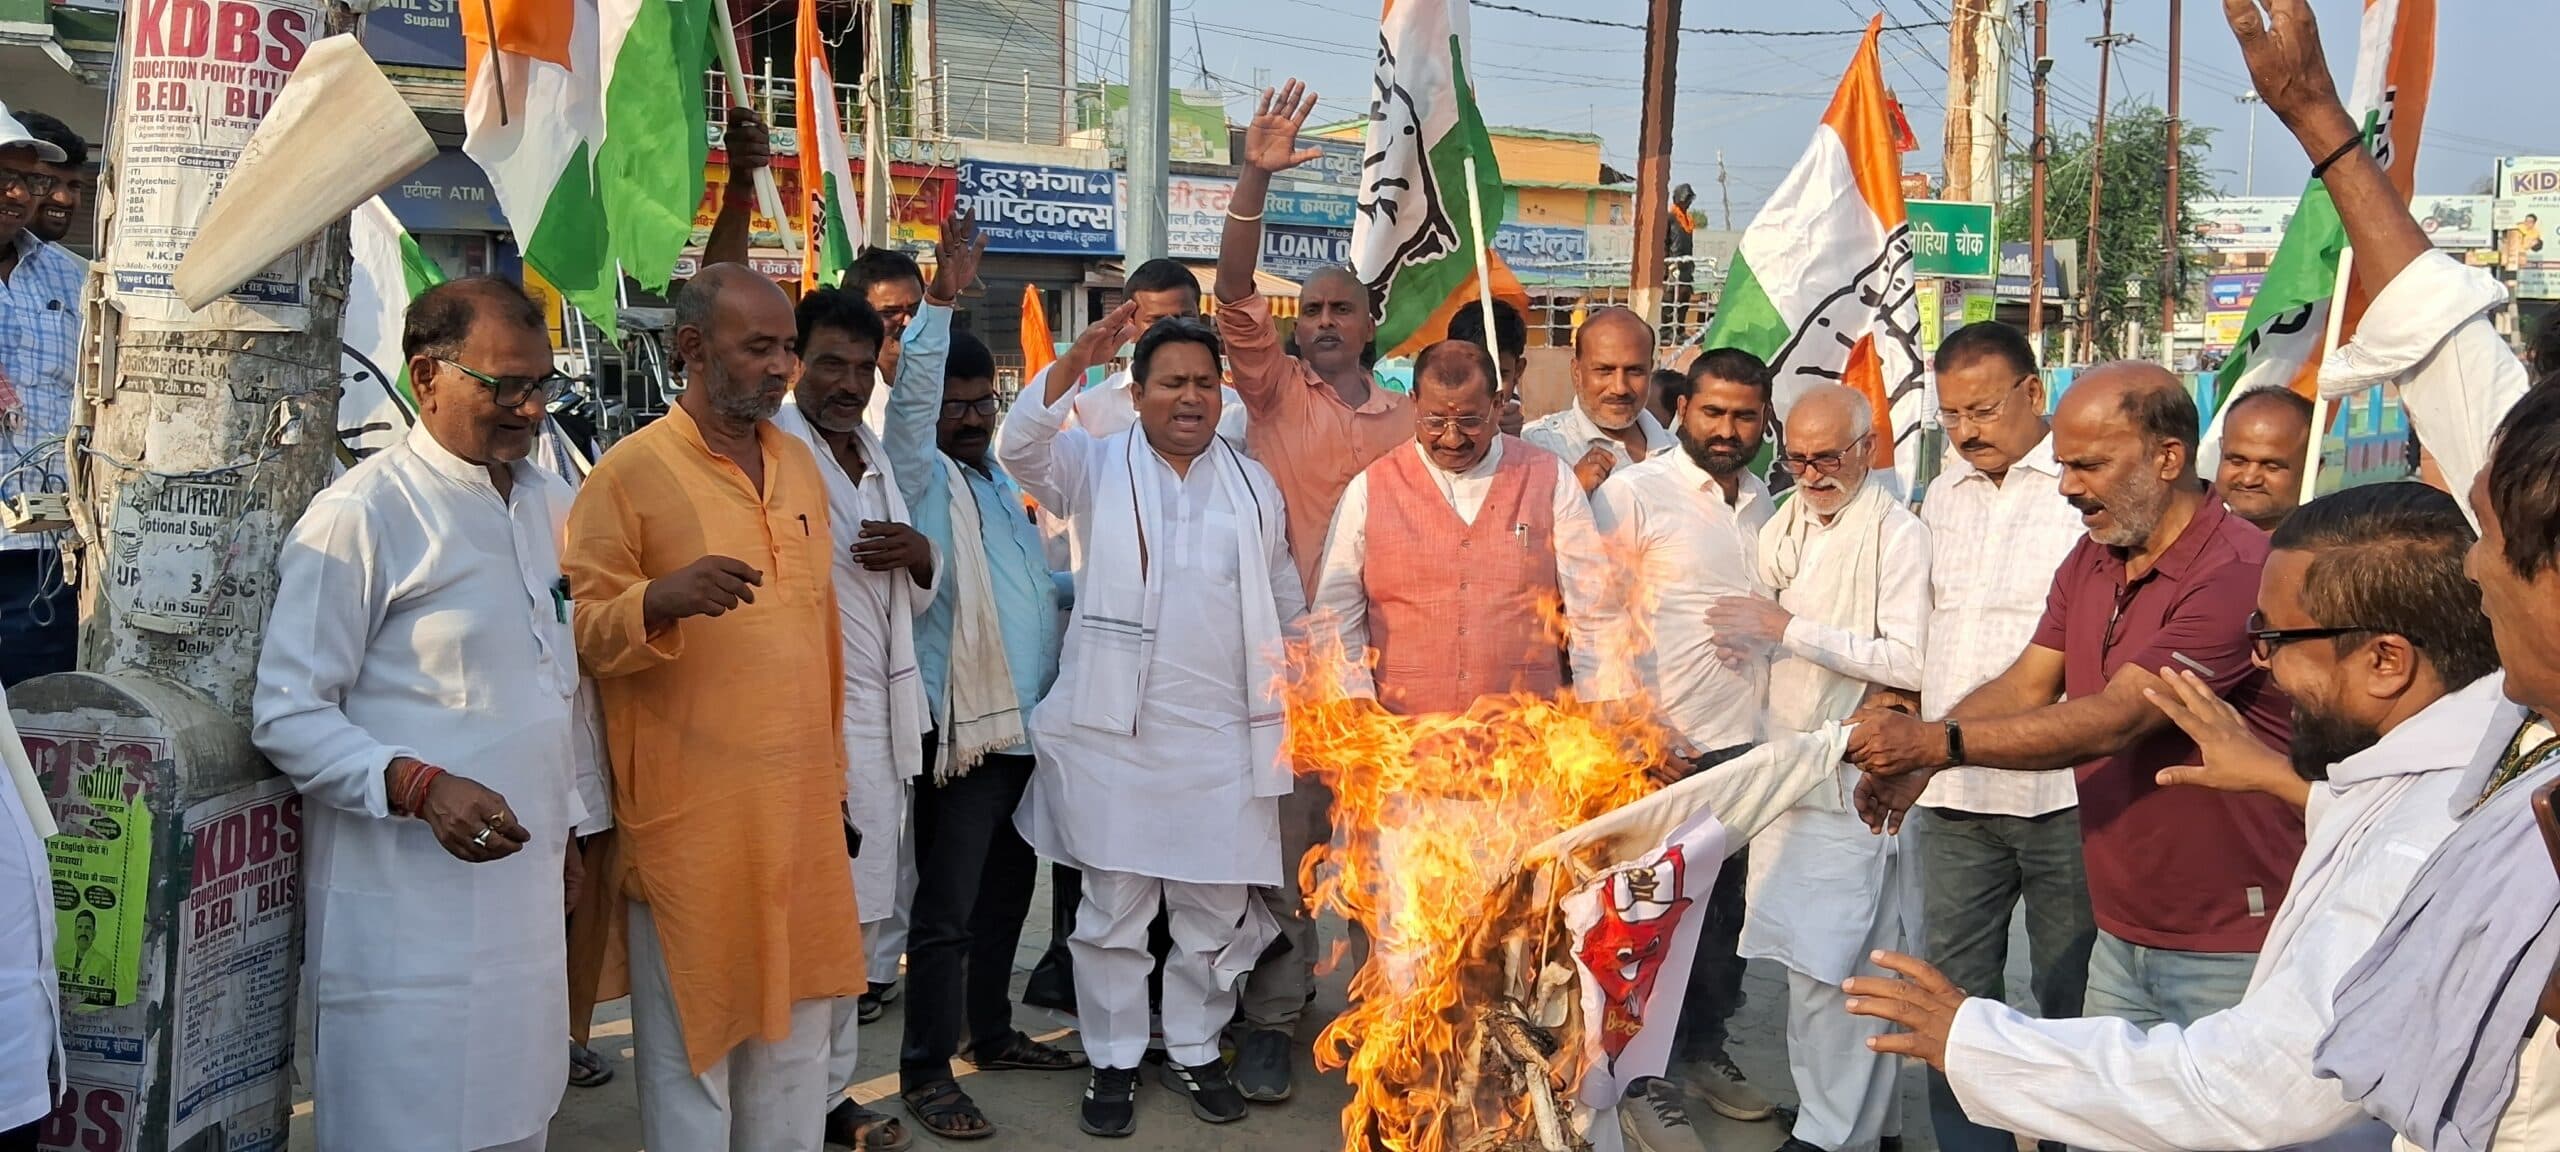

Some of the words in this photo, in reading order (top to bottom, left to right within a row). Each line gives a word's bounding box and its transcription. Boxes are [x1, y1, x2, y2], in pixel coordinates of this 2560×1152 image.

[404, 13, 450, 28] Supaul
[135, 0, 307, 72] KDBS
[133, 61, 197, 80] EDUCATION
[201, 63, 246, 85] POINT
[249, 68, 279, 91] PVT
[136, 82, 193, 112] B.ED.
[180, 157, 220, 168] Courses
[402, 181, 441, 199] एटीएम
[449, 187, 484, 200] ATM
[980, 168, 1086, 194] दरभंगा
[2513, 172, 2560, 193] KID
[955, 189, 1113, 230] ऑप्टिकल्स
[1080, 233, 1107, 248] दुकान
[1267, 233, 1328, 260] LOAN
[1524, 229, 1583, 262] सैलून
[1955, 224, 1984, 256] चौक
[118, 273, 142, 285] Power
[145, 274, 164, 285] Grid
[762, 259, 787, 274] केक
[61, 841, 84, 853] English
[191, 793, 303, 890] KDBS
[190, 875, 239, 911] EDUCATION
[241, 863, 269, 890] POINT
[271, 856, 288, 878] PVT
[194, 896, 237, 940] B.ED.
